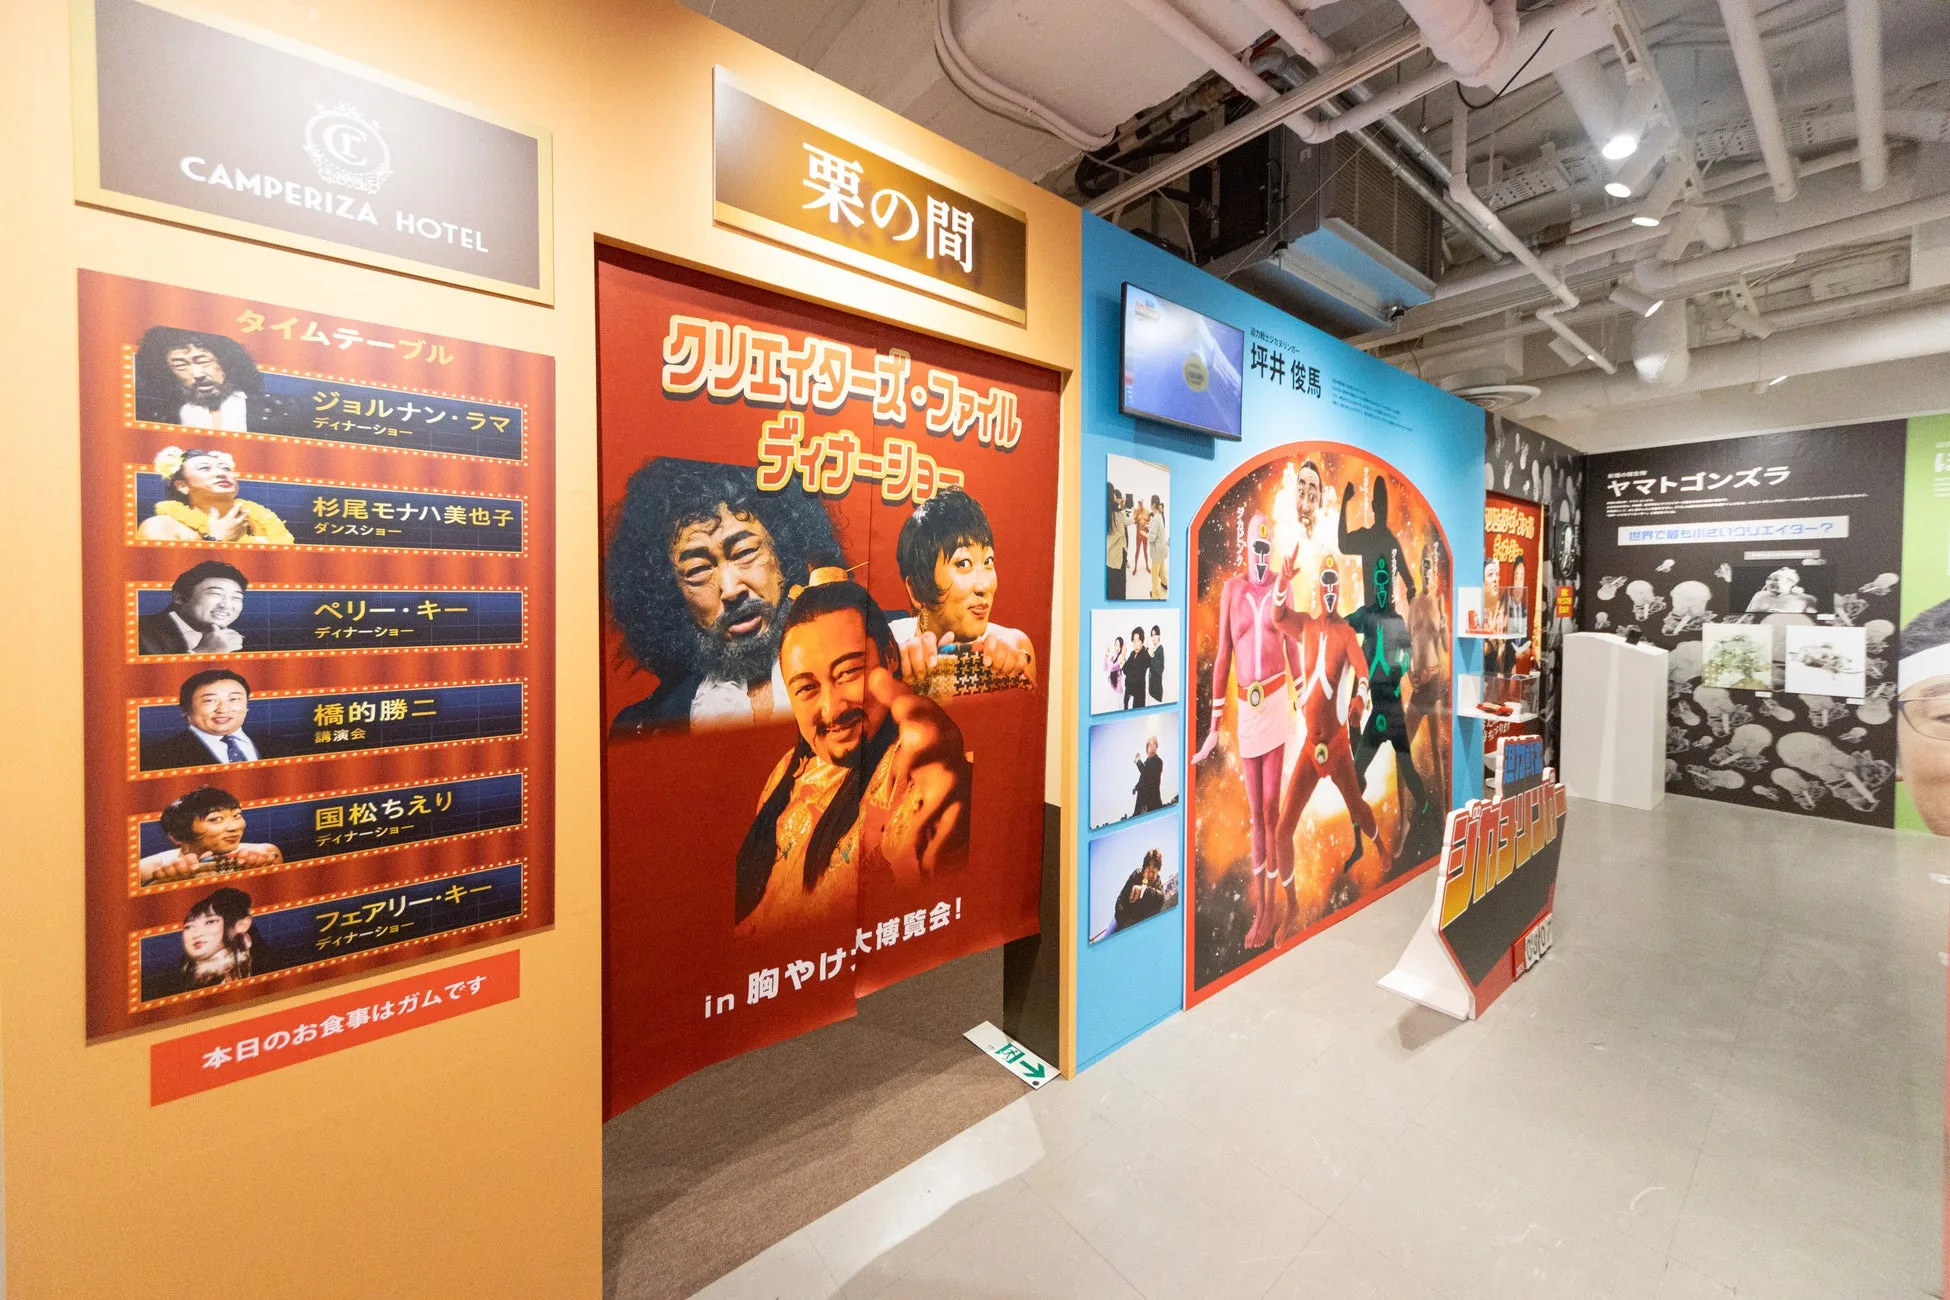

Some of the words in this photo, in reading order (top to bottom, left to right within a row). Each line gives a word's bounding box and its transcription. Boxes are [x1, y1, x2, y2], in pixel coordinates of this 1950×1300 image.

[180, 156, 378, 225] CAMPERIZA
[396, 211, 489, 253] HOTEL
[802, 142, 975, 273] 栗の間
[236, 309, 455, 366] タイムテーブル
[662, 315, 1022, 447] クリエイターズ・ファイル
[1251, 342, 1285, 385] 坪井
[1291, 360, 1322, 399] 俊馬
[312, 391, 511, 434] ジョルナン・ラマ
[313, 417, 413, 437] ディナーショー
[757, 410, 964, 503] ディナーショー
[1607, 466, 1791, 497] ヤマトゴンズラ
[312, 497, 514, 528] 杉尾モナハ美也子
[313, 521, 402, 537] ダンスショー
[313, 600, 468, 622] ペリー・キー
[314, 625, 414, 640] ディナーショー
[314, 699, 437, 727] 橋的勝二
[314, 728, 366, 744] 講演会
[315, 791, 453, 831] 国松ちえり
[316, 824, 415, 848] ディナーショー
[316, 882, 493, 933] フェアリー・キー
[316, 921, 415, 951] ディナーショー
[704, 992, 735, 1019] in
[202, 975, 487, 1070] 本日のお食事はガムです
